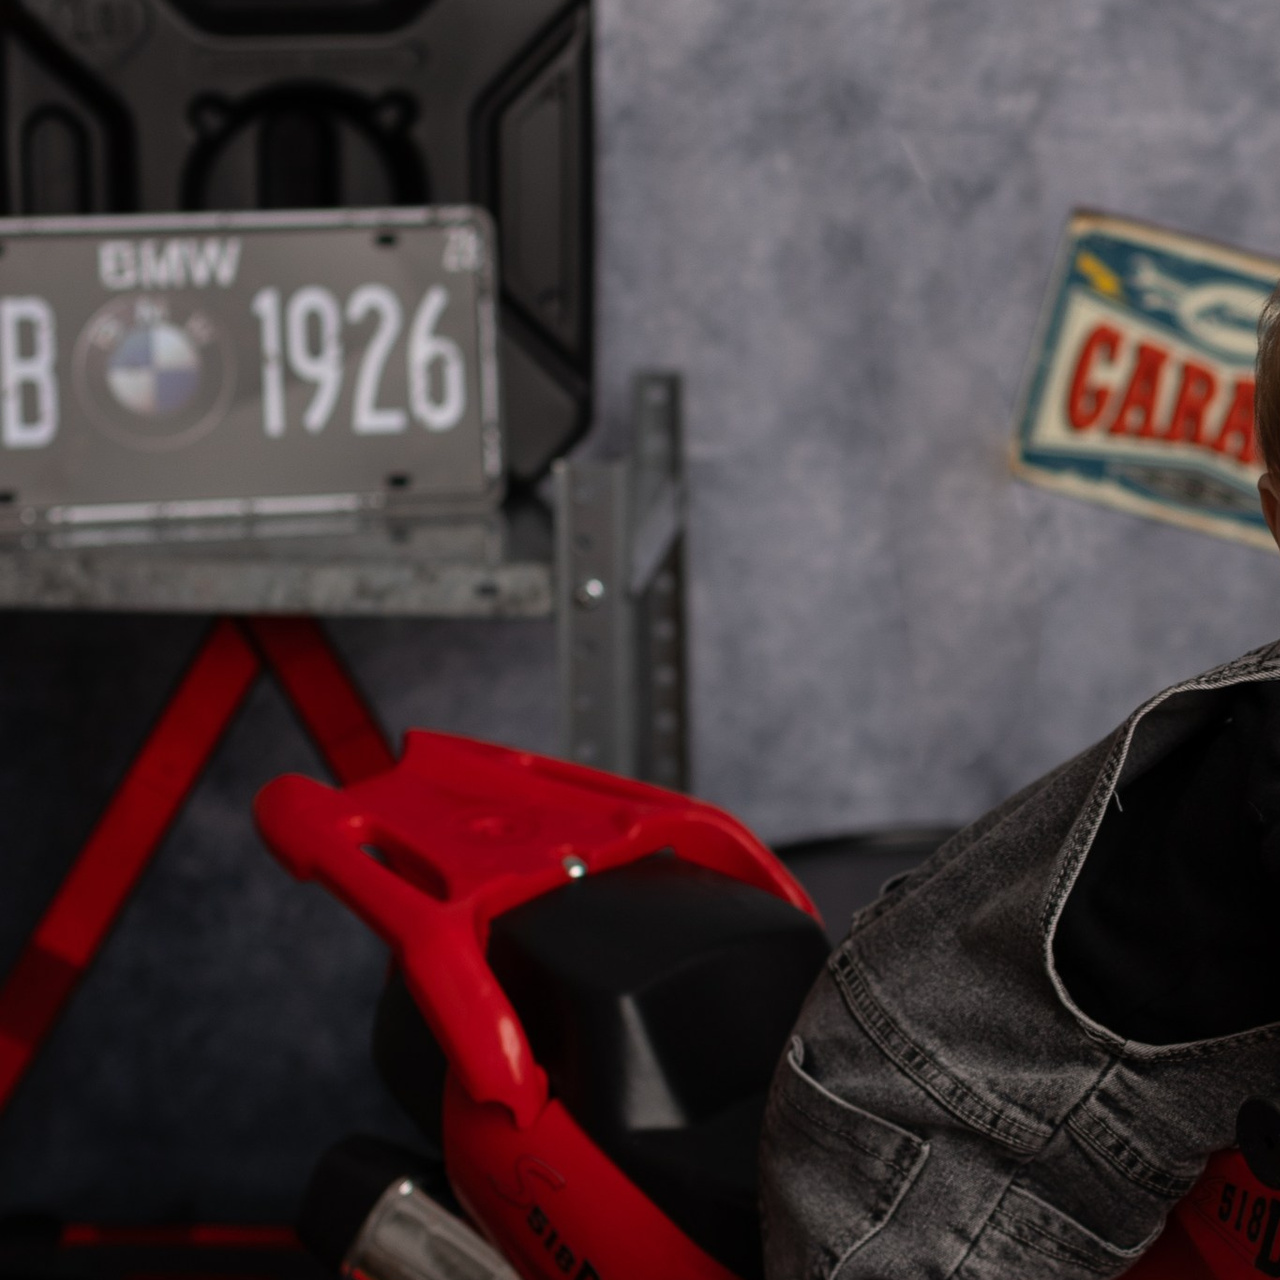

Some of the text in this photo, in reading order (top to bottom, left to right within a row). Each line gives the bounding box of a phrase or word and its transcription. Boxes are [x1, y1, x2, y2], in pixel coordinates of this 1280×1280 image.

[98, 237, 243, 289] BMW
[0, 283, 467, 449] B 1926
